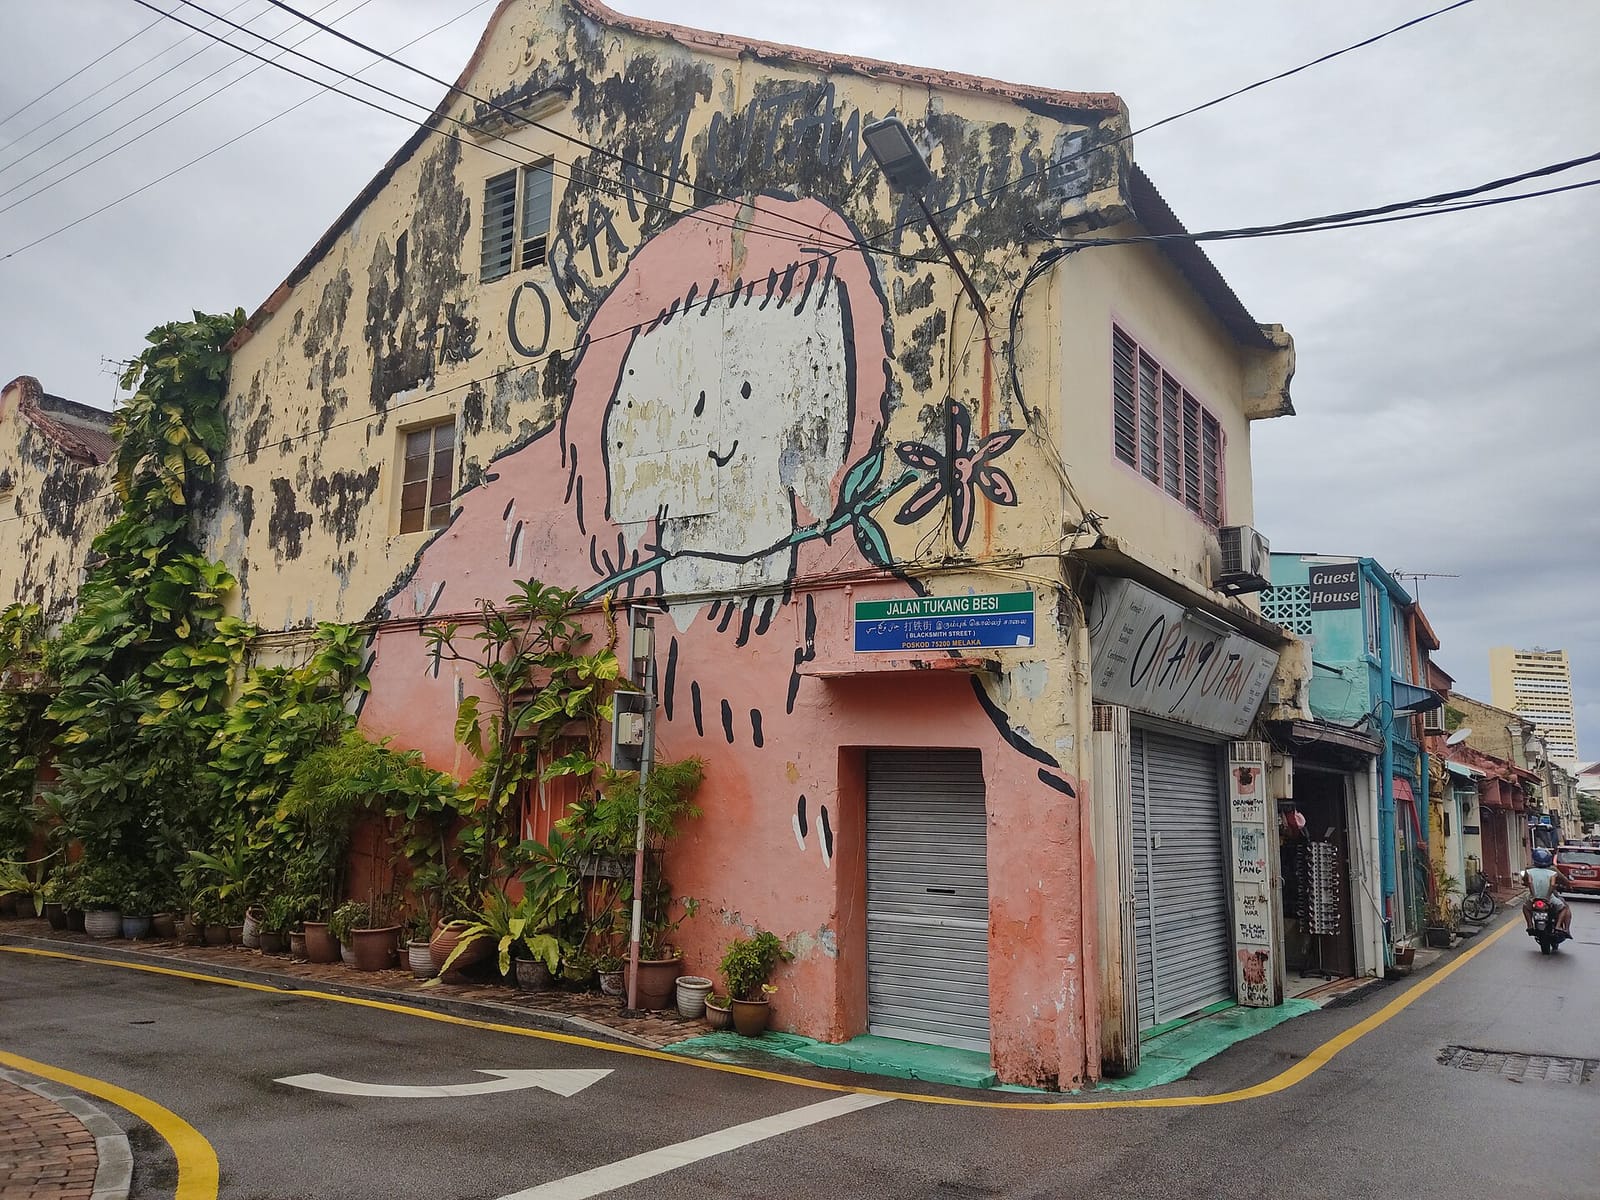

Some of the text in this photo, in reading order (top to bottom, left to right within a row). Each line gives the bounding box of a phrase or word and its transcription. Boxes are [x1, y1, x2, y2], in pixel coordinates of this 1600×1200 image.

[1313, 571, 1356, 585] Guest
[1312, 591, 1359, 604] House
[886, 596, 999, 615] JALAN TUKANG BESI
[910, 630, 947, 638] BLACKSMITH
[948, 629, 973, 637] STREET
[902, 639, 982, 649] POSKOD 75200 MELAKA
[1238, 859, 1254, 867] YIN
[1238, 866, 1262, 874] YANG
